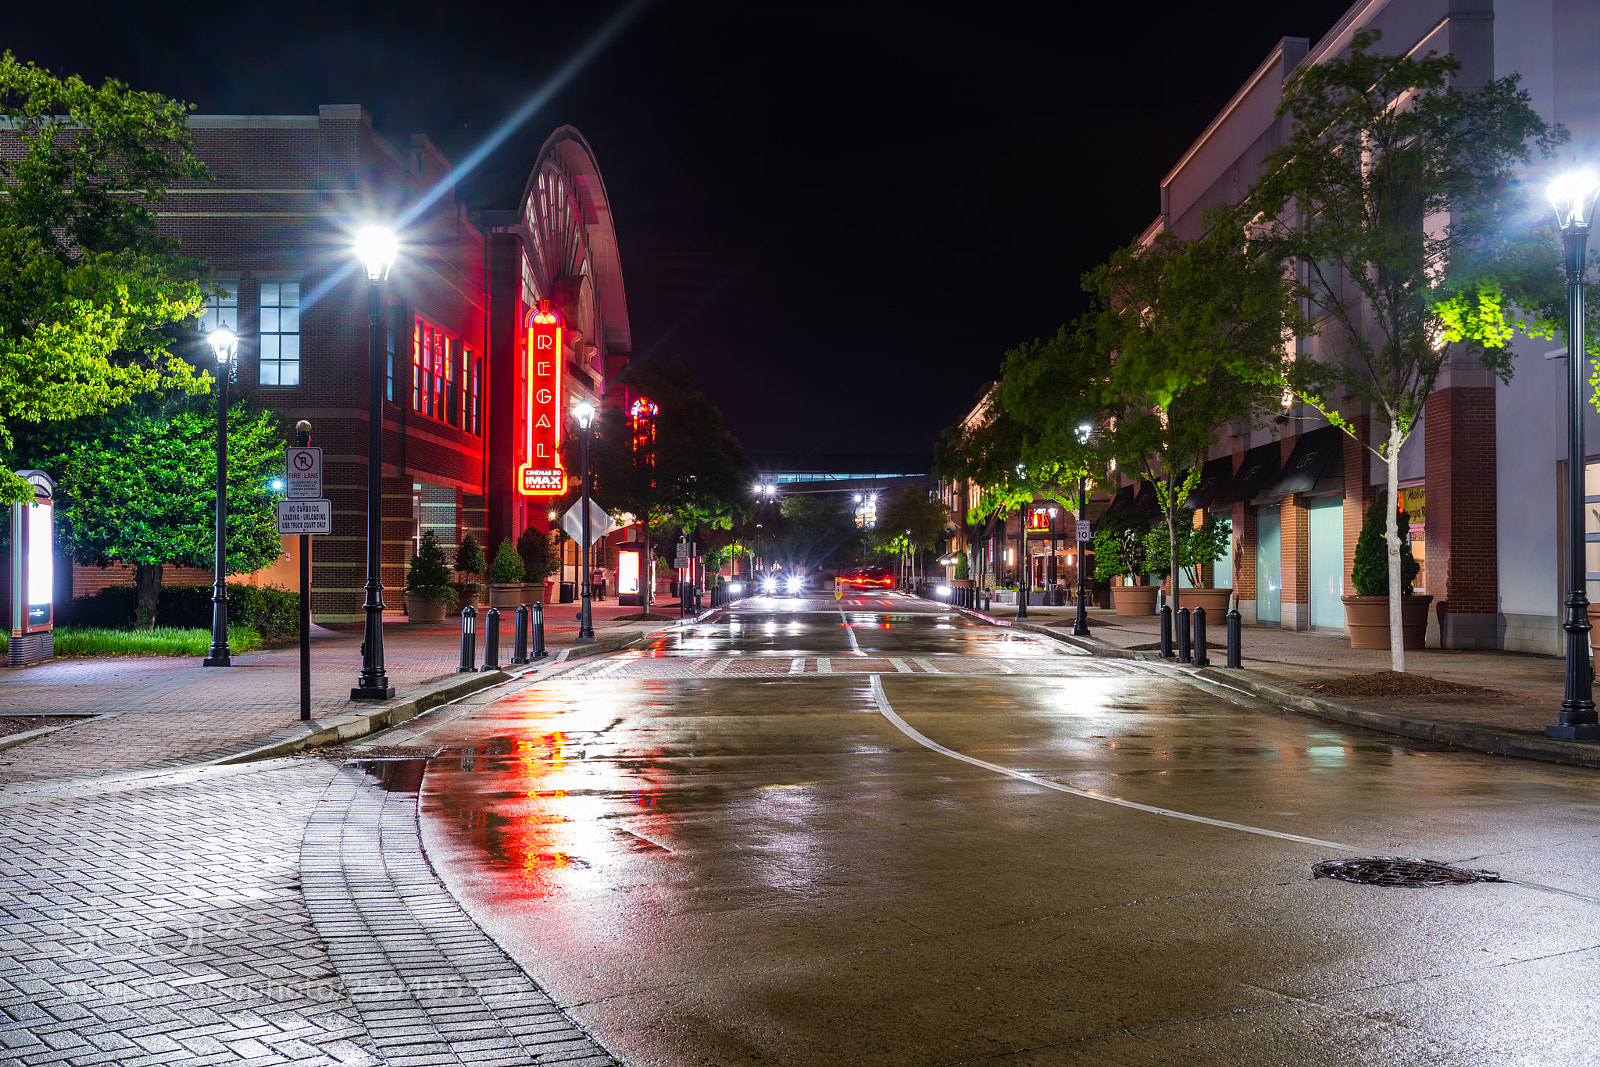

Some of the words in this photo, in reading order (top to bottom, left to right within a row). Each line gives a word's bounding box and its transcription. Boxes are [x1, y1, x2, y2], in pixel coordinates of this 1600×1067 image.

[535, 334, 552, 458] REGAL
[1295, 451, 1318, 469] LOFT
[525, 476, 561, 485] IMAX
[282, 513, 300, 521] LOADING
[303, 513, 326, 521] UNLOADING
[1027, 508, 1050, 529] BONES
[303, 521, 316, 529] COURT
[1078, 531, 1088, 539] 10
